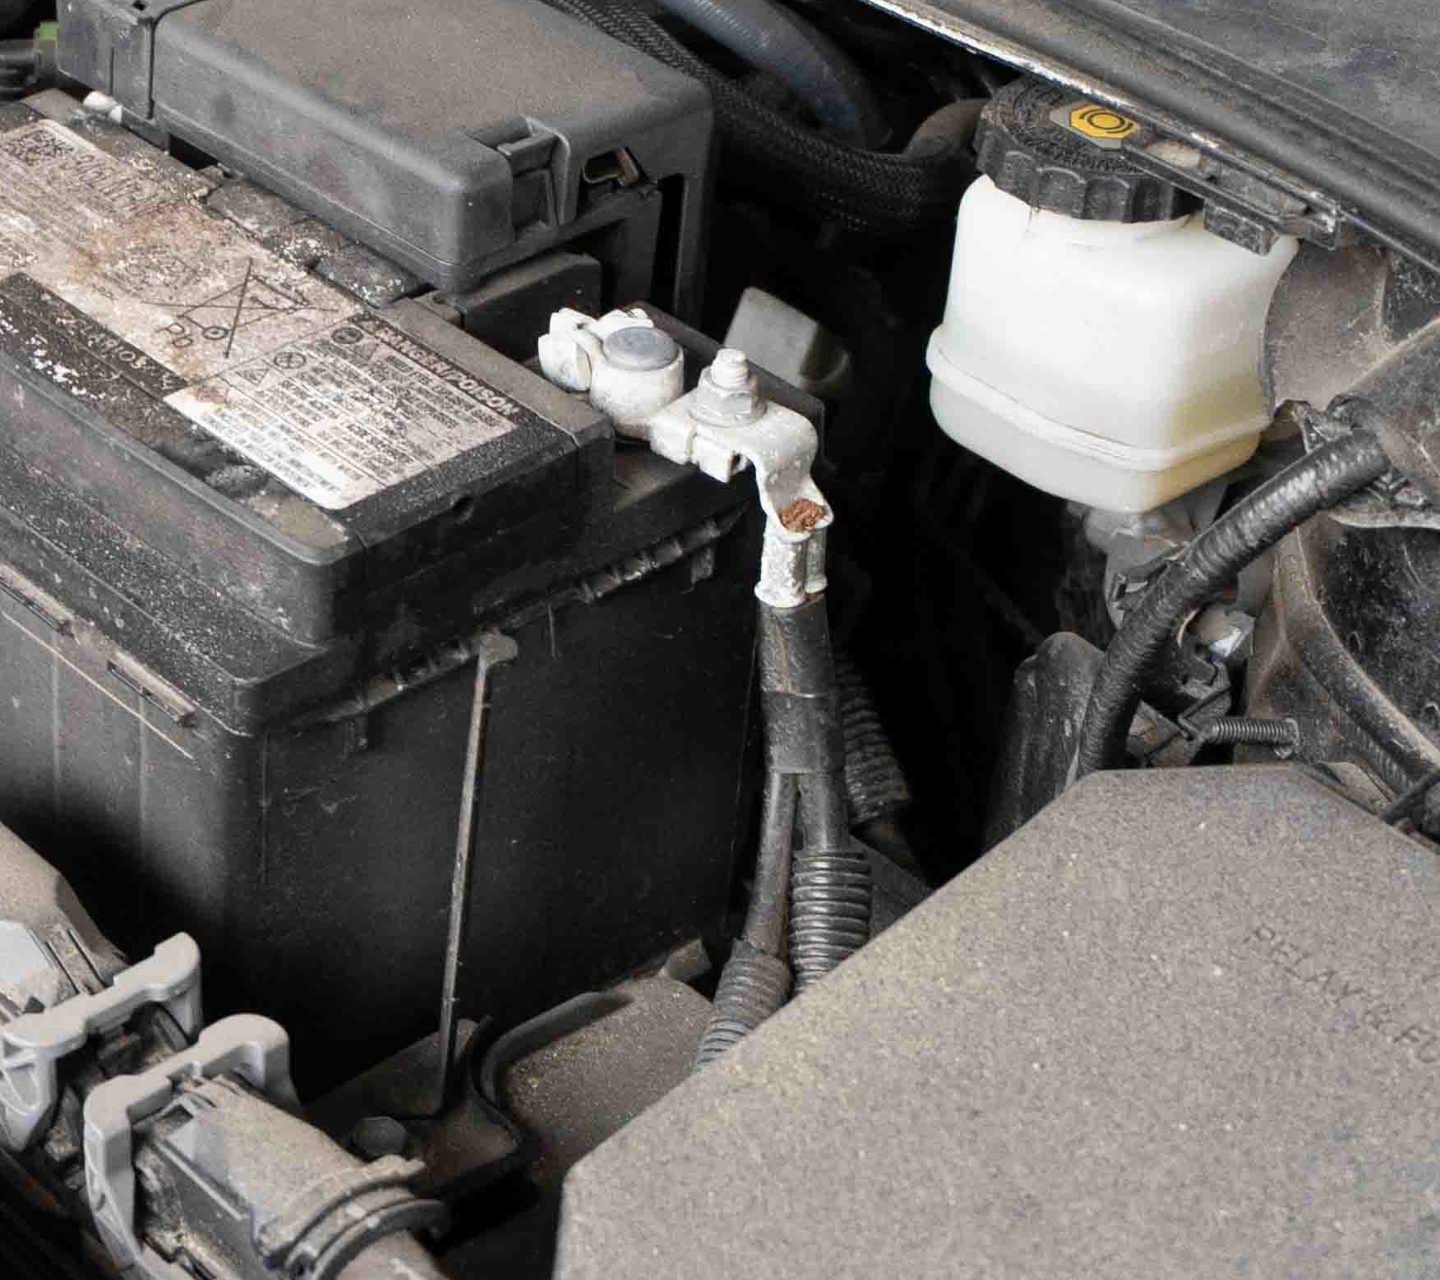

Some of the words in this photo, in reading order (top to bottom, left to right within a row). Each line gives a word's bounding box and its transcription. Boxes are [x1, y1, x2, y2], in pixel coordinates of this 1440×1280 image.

[155, 321, 195, 349] Pb
[372, 325, 521, 418] DANGER/POISON
[1242, 924, 1365, 1007] RELAY
